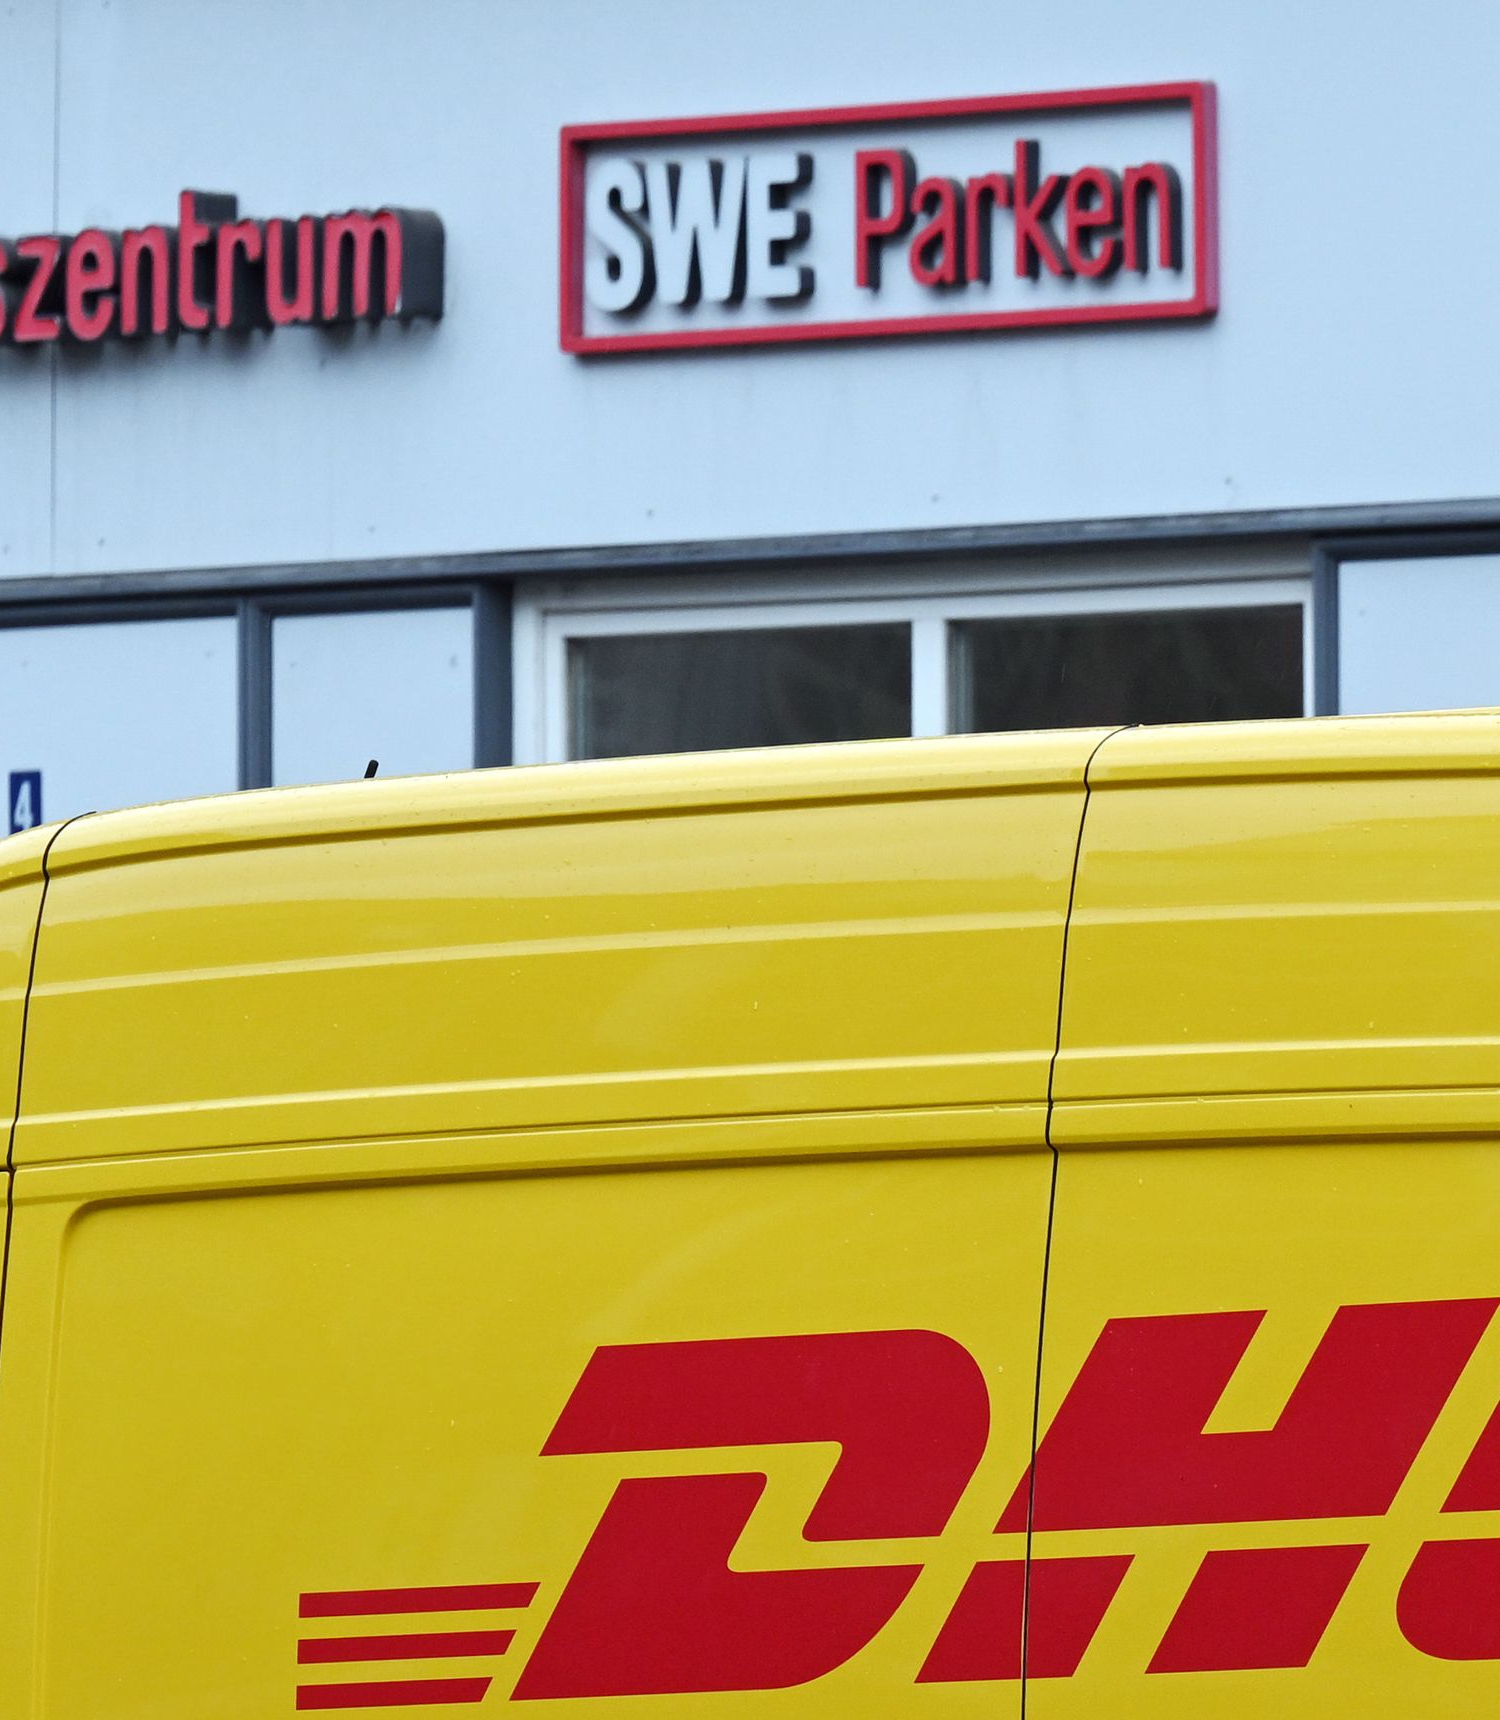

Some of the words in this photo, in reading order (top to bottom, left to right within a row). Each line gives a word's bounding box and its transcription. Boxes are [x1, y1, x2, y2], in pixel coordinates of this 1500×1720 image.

[586, 152, 812, 313] SWE
[854, 139, 1182, 291] Parken
[13, 780, 34, 829] 4
